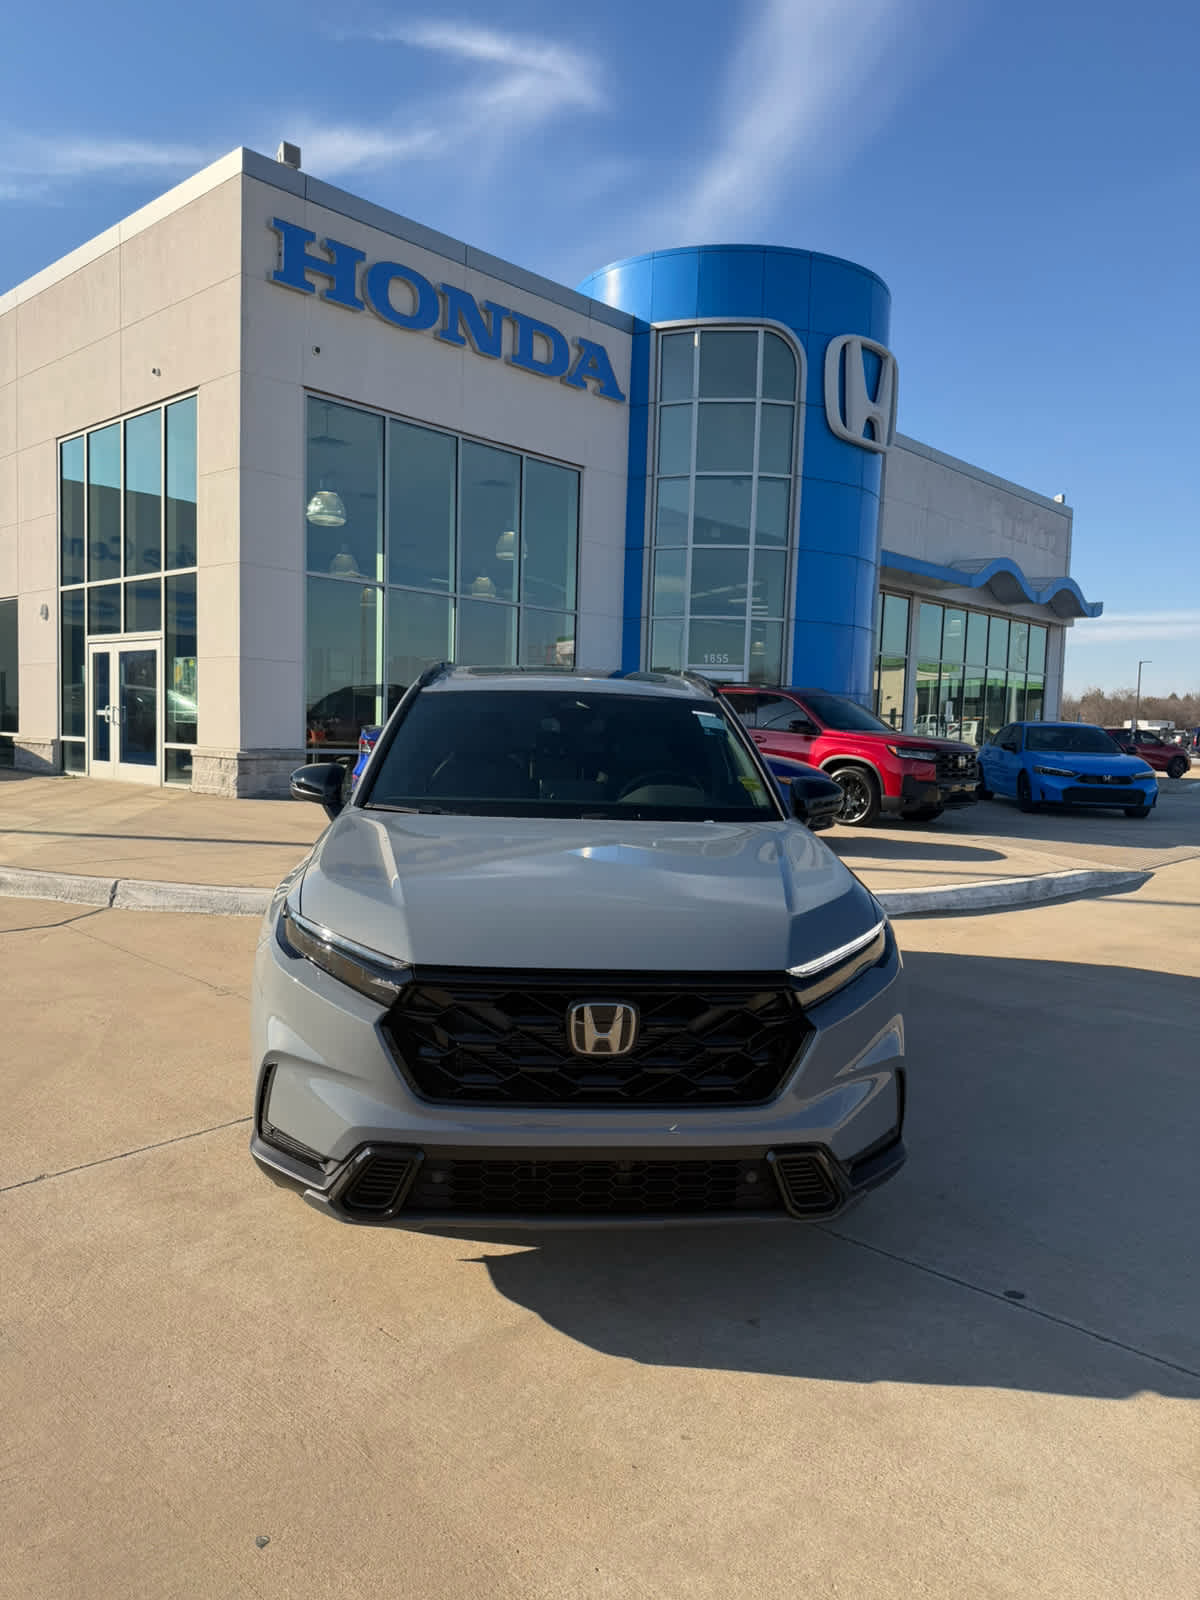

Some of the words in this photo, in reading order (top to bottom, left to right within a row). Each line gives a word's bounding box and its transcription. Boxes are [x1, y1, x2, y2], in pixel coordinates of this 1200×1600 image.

[266, 217, 626, 402] HONDA
[844, 336, 897, 449] H
[703, 653, 729, 664] 1655
[582, 1003, 625, 1054] H
